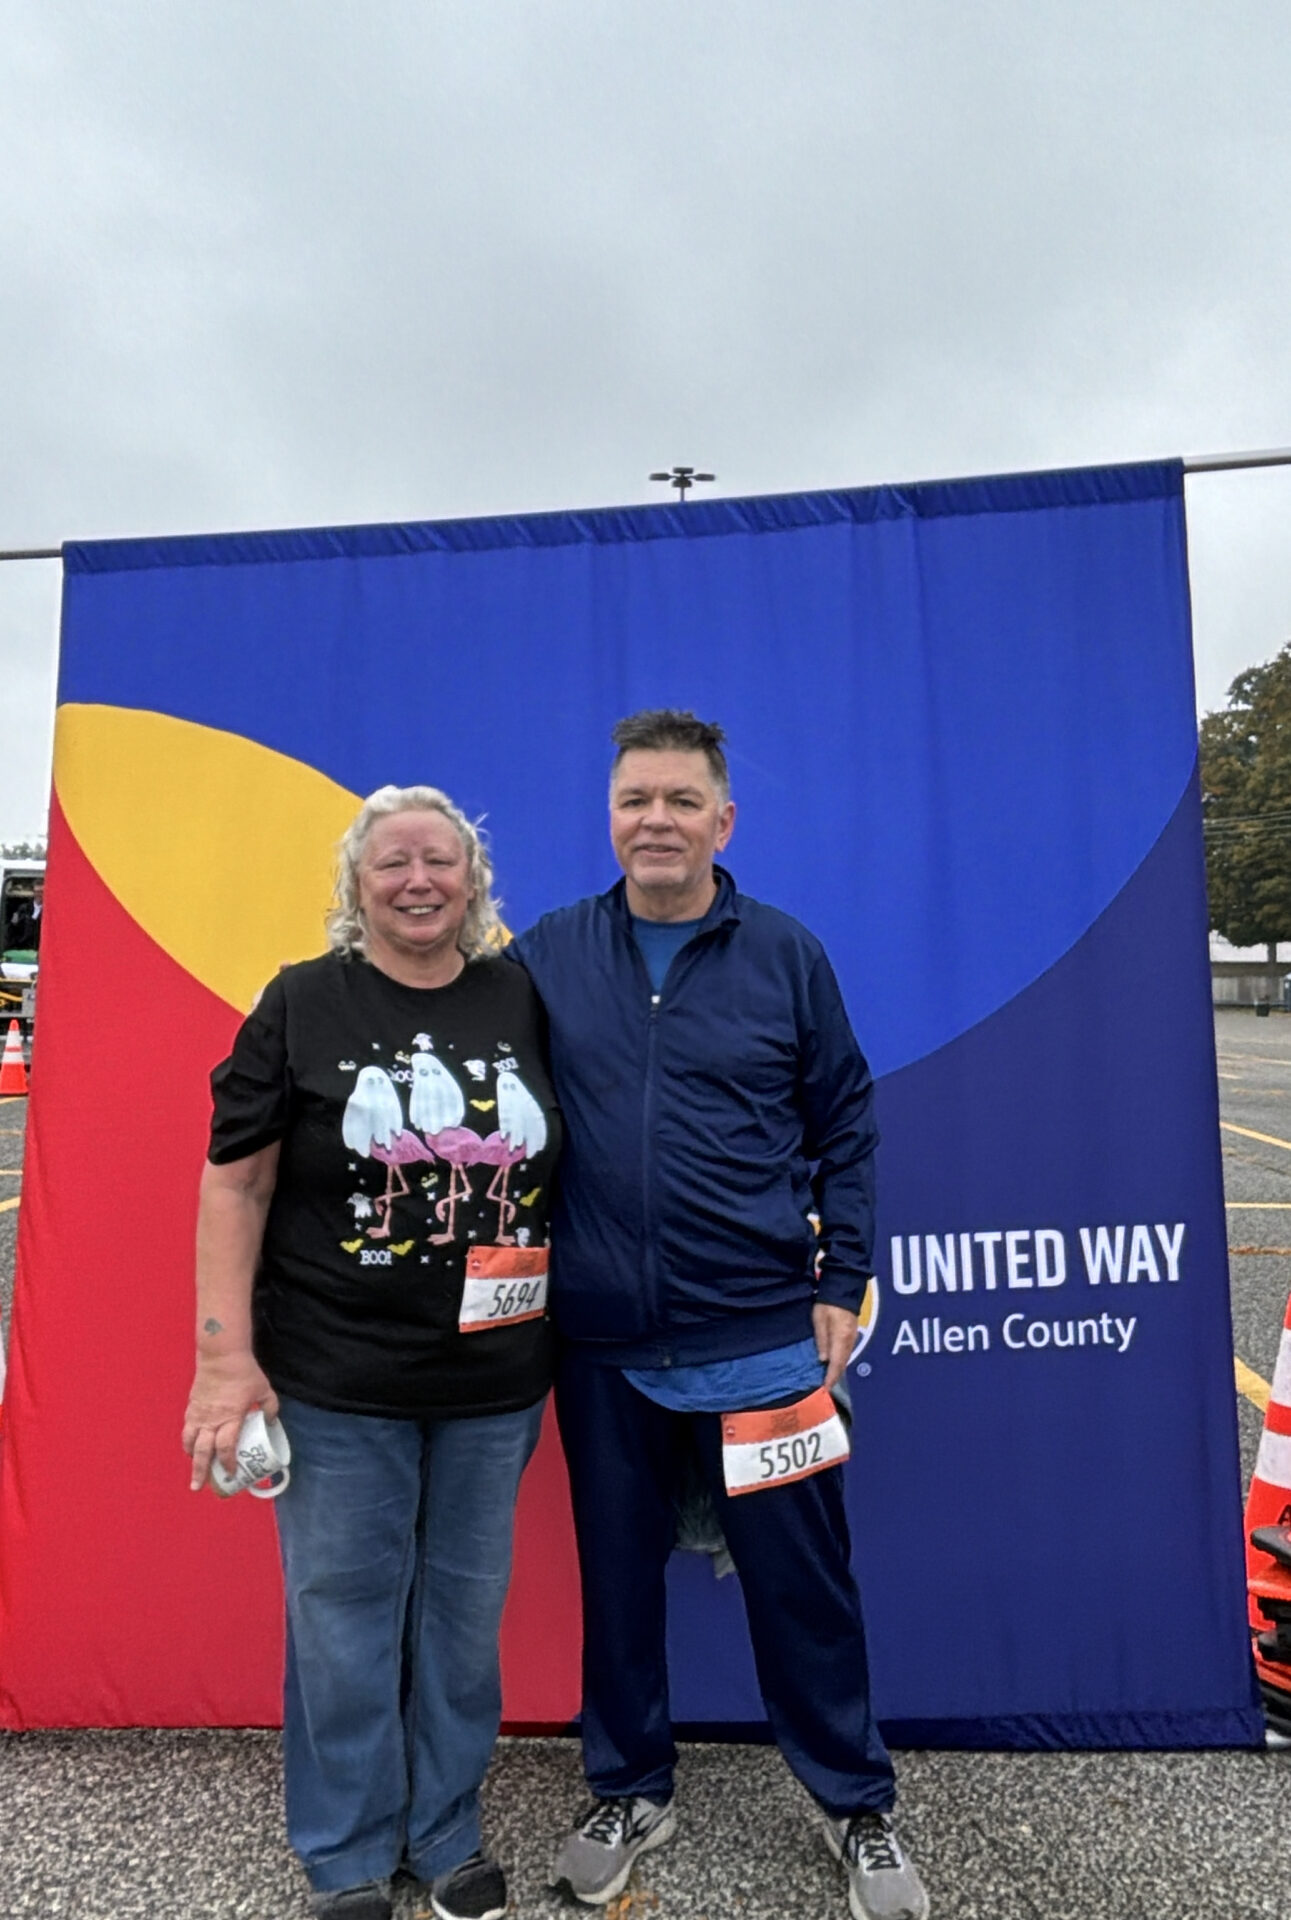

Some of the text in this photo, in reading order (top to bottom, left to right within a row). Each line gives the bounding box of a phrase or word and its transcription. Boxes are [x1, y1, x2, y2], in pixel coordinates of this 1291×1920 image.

[360, 1249, 392, 1265] BOO!
[890, 1223, 1186, 1295] UNITED WAY
[488, 1280, 542, 1318] 5694
[891, 1312, 1137, 1355] Allen County
[760, 1432, 823, 1479] 5502
